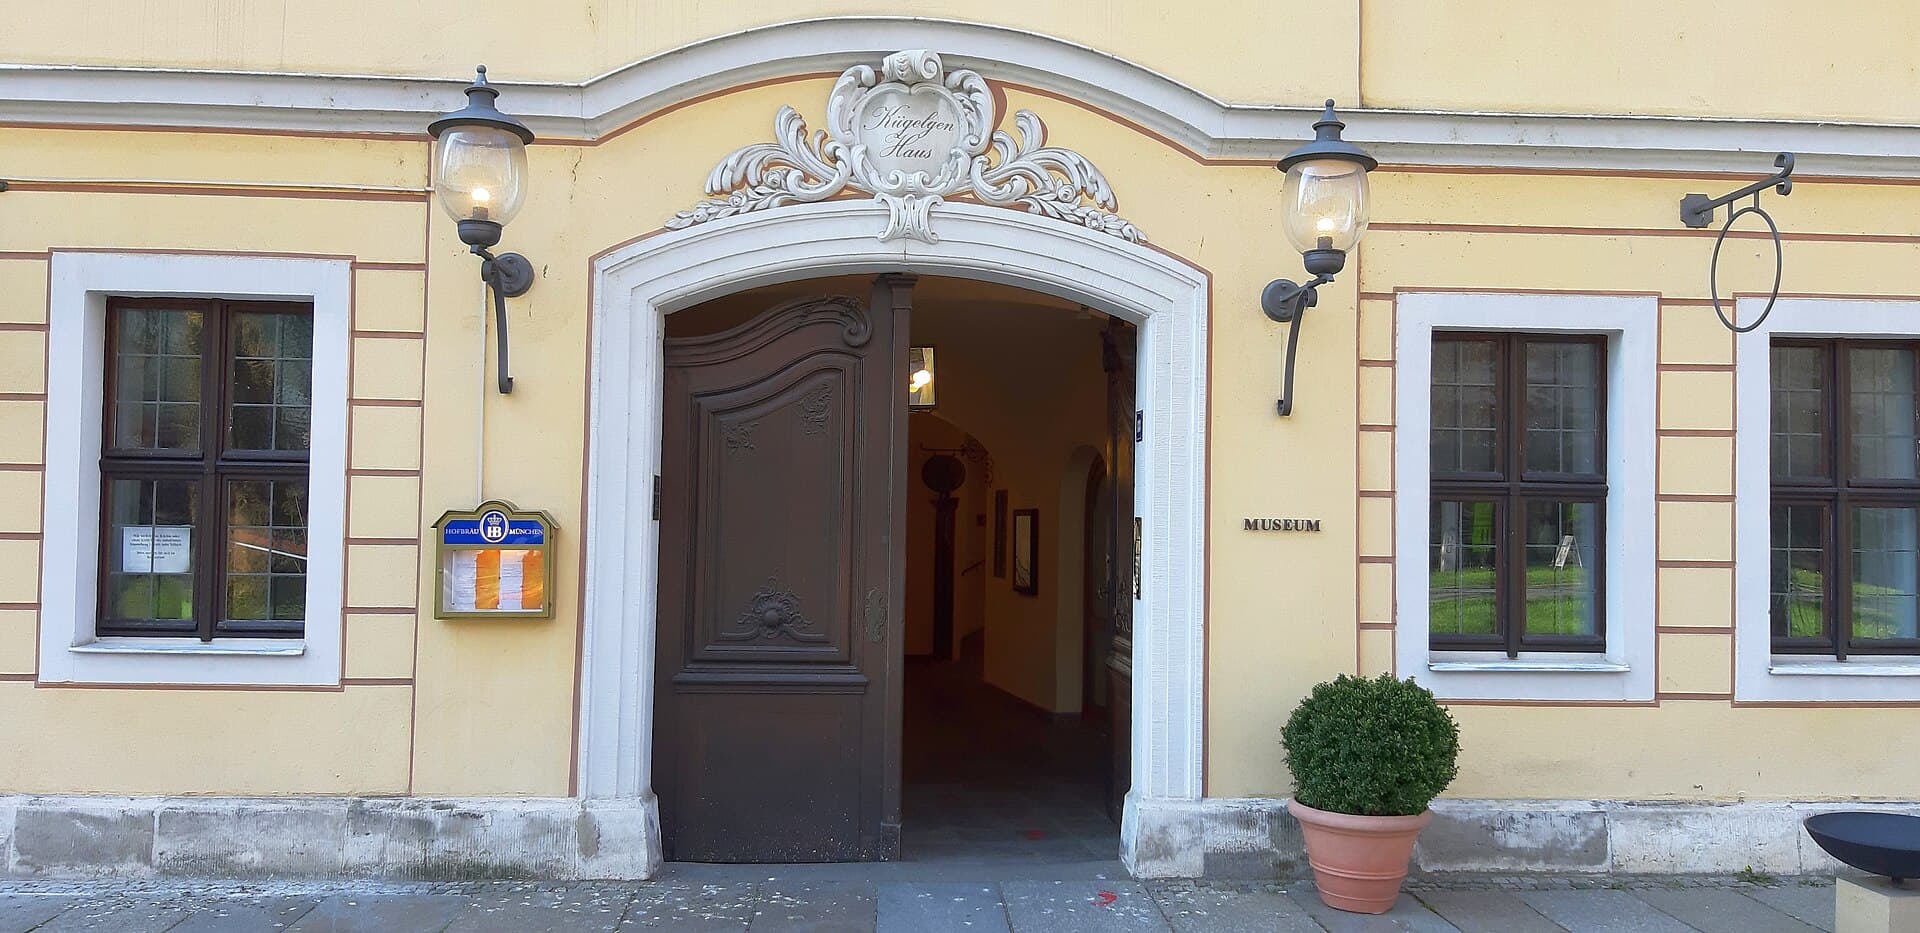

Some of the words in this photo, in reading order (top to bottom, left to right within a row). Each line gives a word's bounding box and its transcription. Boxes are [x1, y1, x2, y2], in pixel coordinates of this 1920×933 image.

[864, 104, 954, 139] Kügelgen
[880, 133, 933, 159] Haus
[445, 527, 480, 535] HOFBRÄU
[508, 527, 544, 535] MÜNCHEN
[1243, 518, 1321, 532] MUSEUM
